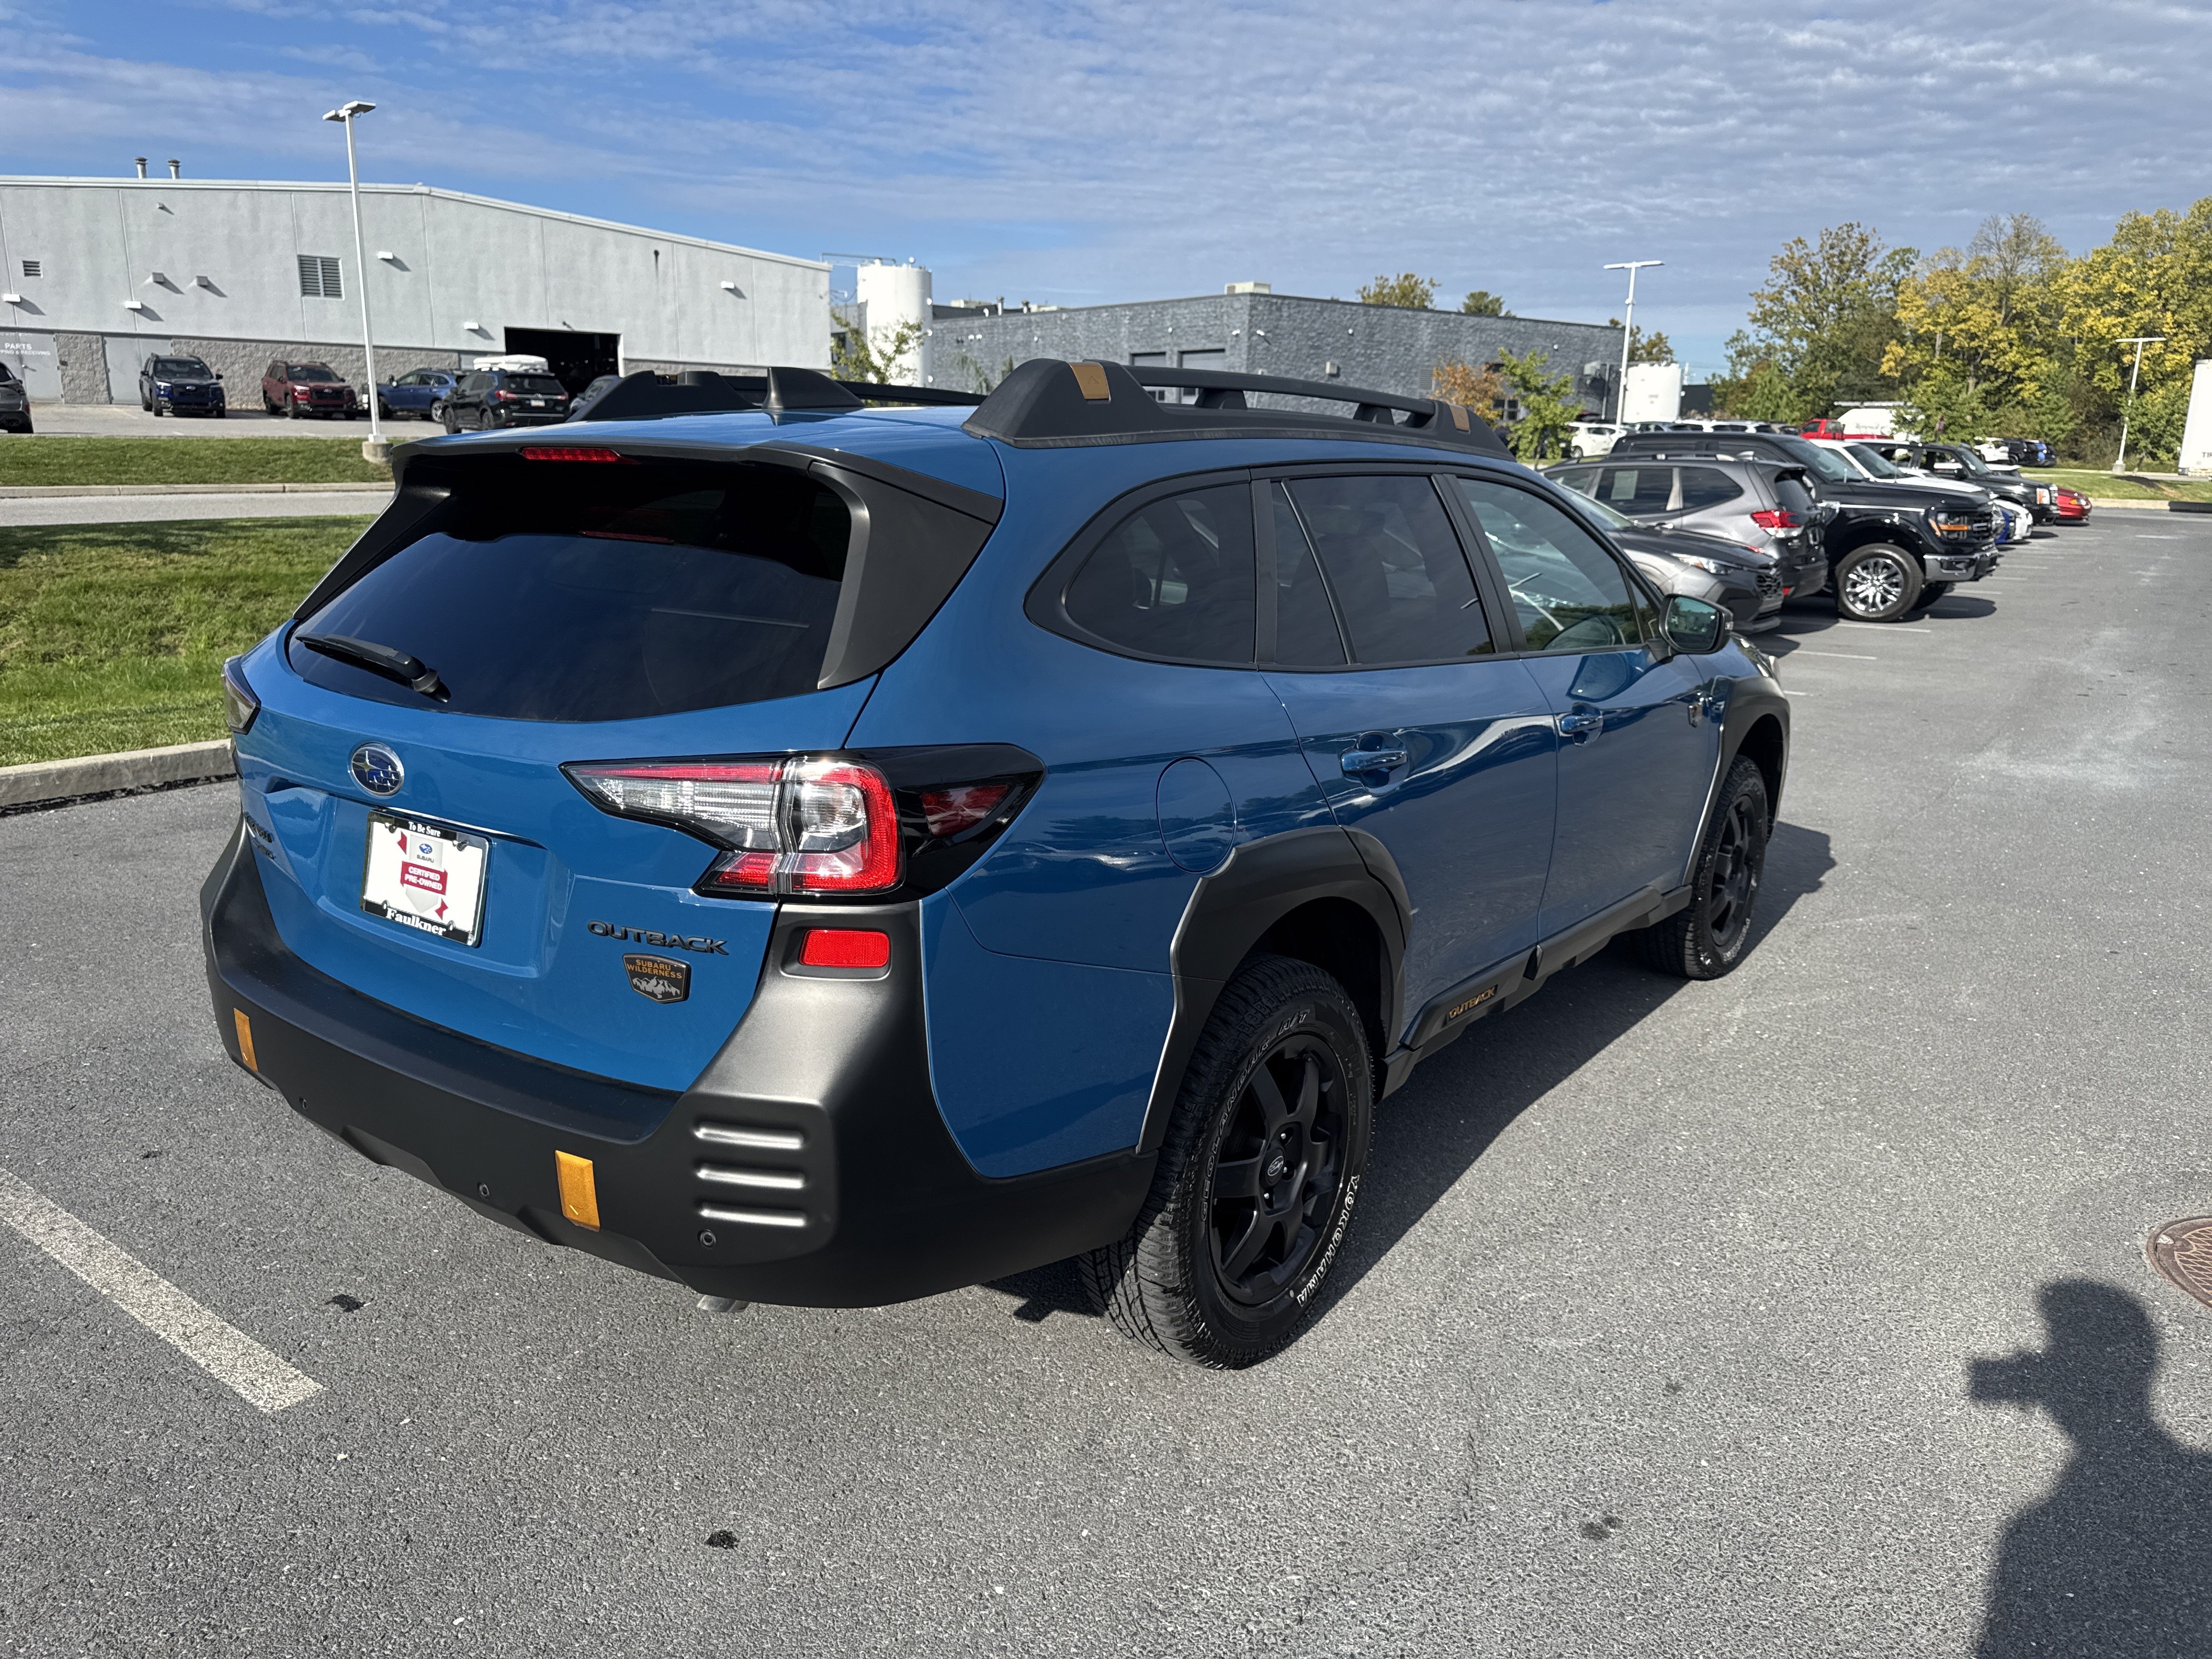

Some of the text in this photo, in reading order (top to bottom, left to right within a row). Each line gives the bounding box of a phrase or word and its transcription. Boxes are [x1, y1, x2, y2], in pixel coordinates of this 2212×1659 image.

[408, 821, 441, 837] To Be Sure
[416, 854, 435, 863] SUBARU
[404, 873, 443, 891] PRE-OWNED
[408, 866, 441, 881] CERTIFIED
[386, 907, 447, 936] Faulkner
[588, 920, 729, 955] OUTBACK
[627, 963, 682, 979] WILDERNESS
[636, 959, 671, 971] SUBARU
[1449, 986, 1497, 1019] OUTBACK
[1200, 1035, 1271, 1222] GEOLANDAR
[1296, 1175, 1361, 1307] YOKOHAMA
